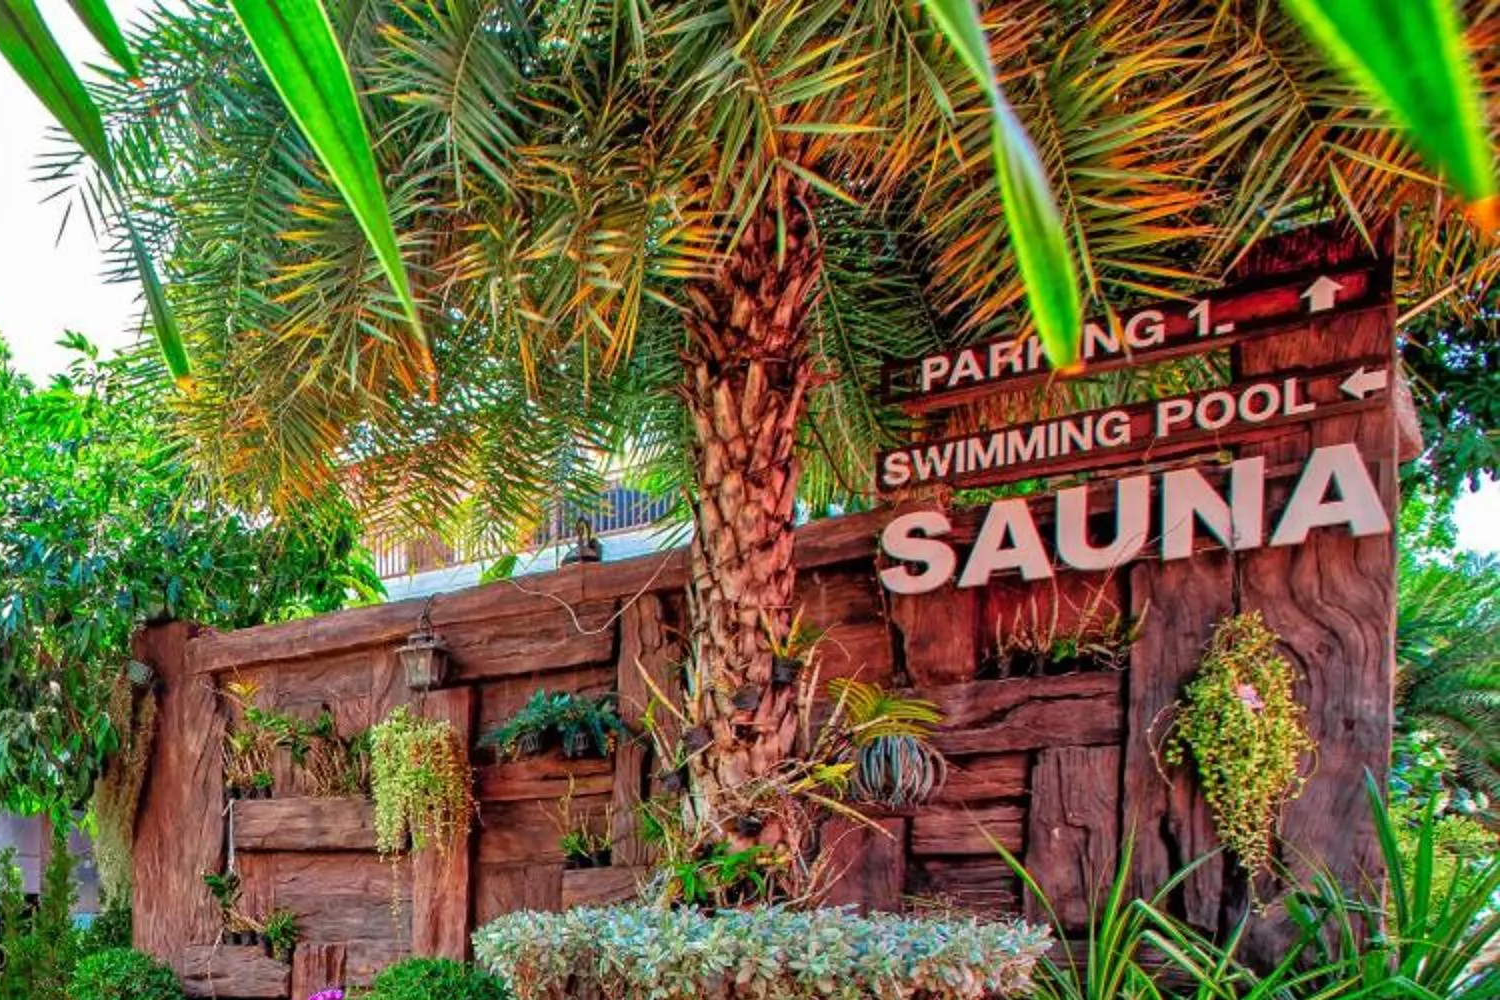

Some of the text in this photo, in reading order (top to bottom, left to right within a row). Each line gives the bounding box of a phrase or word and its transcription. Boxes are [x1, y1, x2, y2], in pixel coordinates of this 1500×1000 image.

[921, 309, 1166, 392] PARNG
[882, 377, 1316, 487] SWIMMING POOL
[879, 443, 1391, 595] SAUNA
